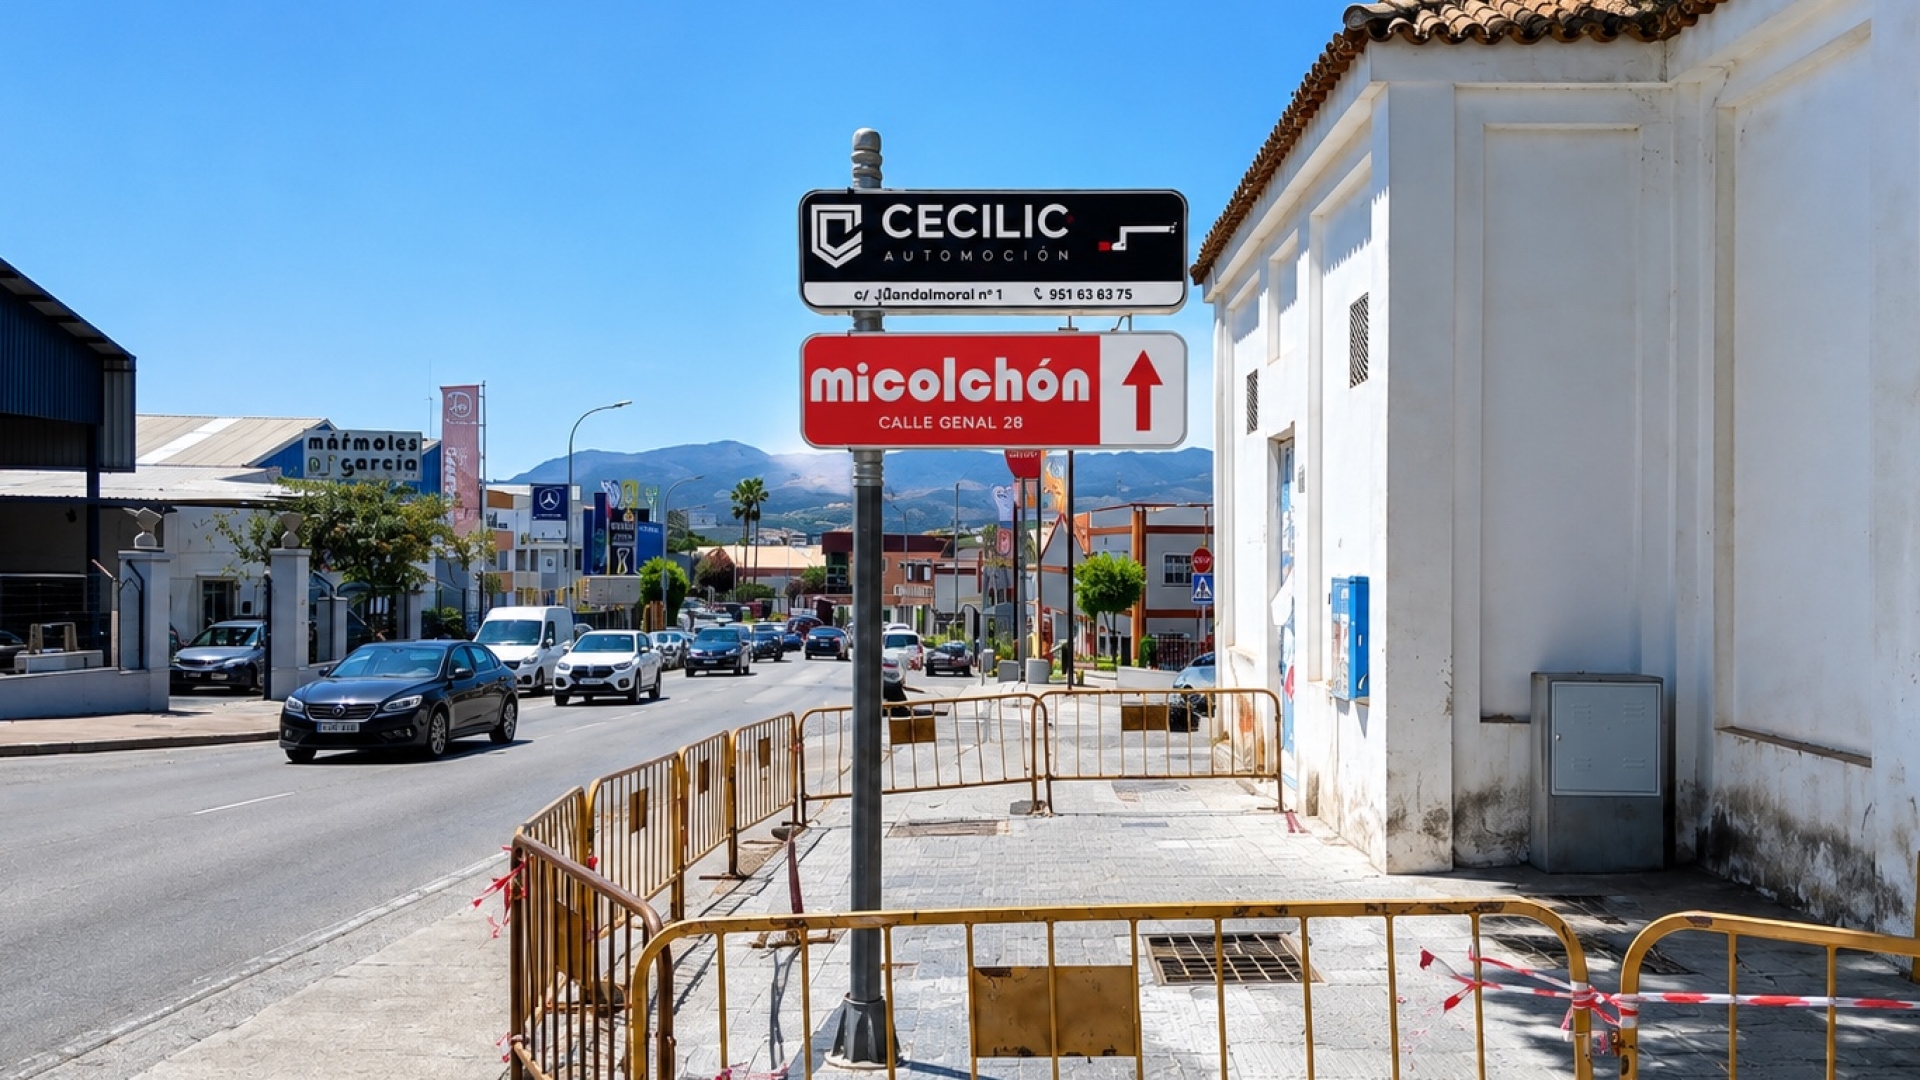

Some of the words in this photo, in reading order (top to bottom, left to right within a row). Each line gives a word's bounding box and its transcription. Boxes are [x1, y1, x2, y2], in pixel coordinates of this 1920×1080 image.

[881, 203, 1069, 239] CECILIC
[883, 245, 1069, 262] AUTOMOCIÓN
[854, 289, 869, 301] c/
[996, 288, 1003, 300] 1
[1049, 288, 1072, 300] 951
[1076, 288, 1094, 300] 63
[1096, 288, 1113, 300] 63
[1116, 288, 1133, 300] 75
[810, 356, 1090, 403] micolchón
[878, 416, 934, 429] CALLE
[939, 416, 998, 429] GENAL
[1003, 416, 1023, 429] 28
